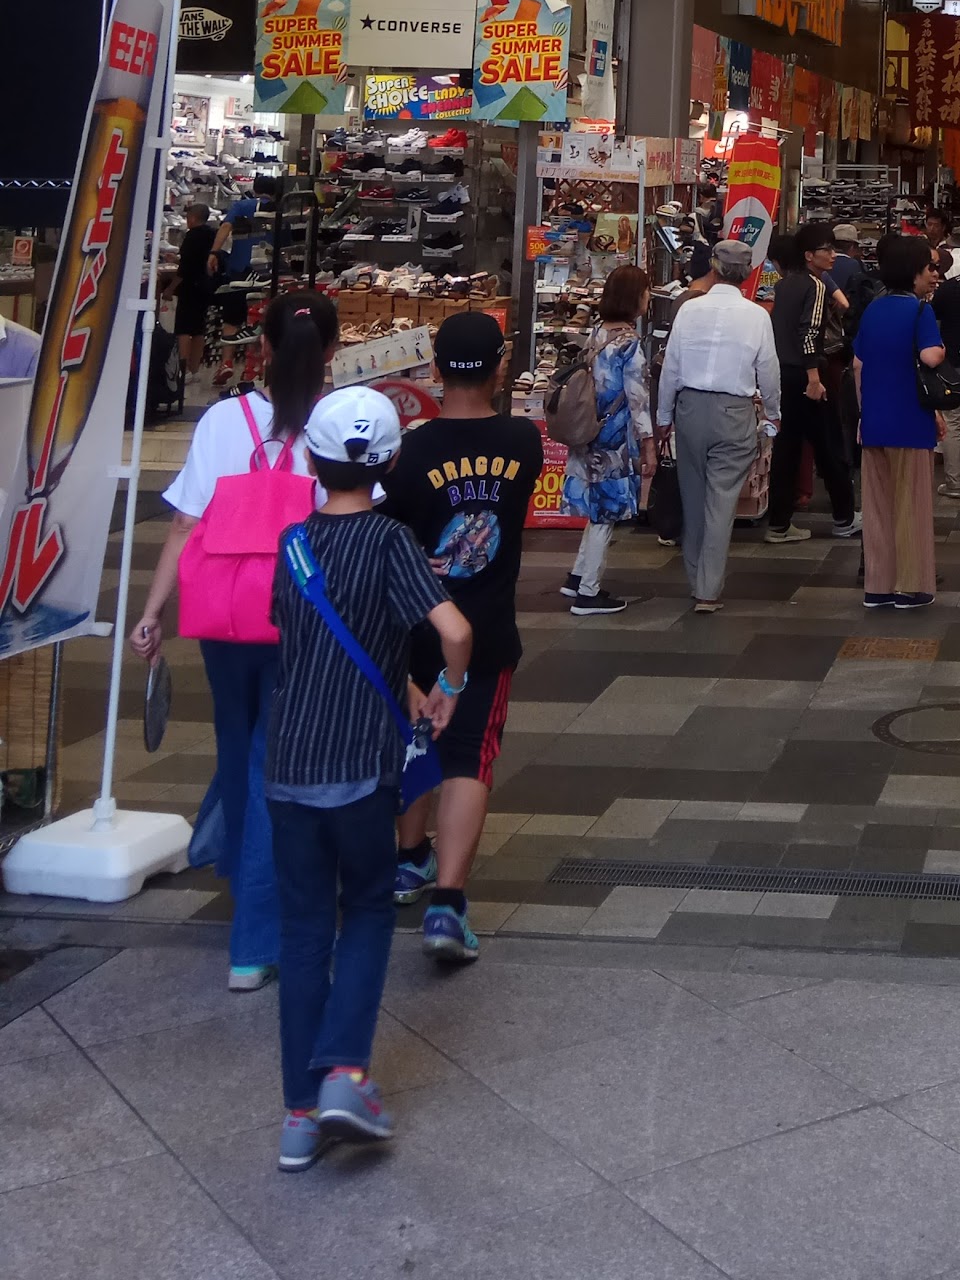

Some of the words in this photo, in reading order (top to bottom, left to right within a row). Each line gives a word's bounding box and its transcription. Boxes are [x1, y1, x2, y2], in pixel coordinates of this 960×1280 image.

[180, 21, 201, 36] THE
[201, 20, 227, 35] WALL
[264, 17, 318, 34] SUPER
[377, 19, 462, 34] CONVERSE
[482, 22, 538, 39] SUPER
[272, 32, 343, 51] SUMMER
[491, 38, 562, 56] SUMMER
[261, 50, 341, 80] SALE
[480, 55, 561, 85] SALE
[366, 77, 410, 95] SUPER
[730, 66, 750, 87] Reebok
[367, 85, 429, 110] CHOICE
[427, 455, 521, 490] DRAGON
[447, 480, 501, 507] BALL
